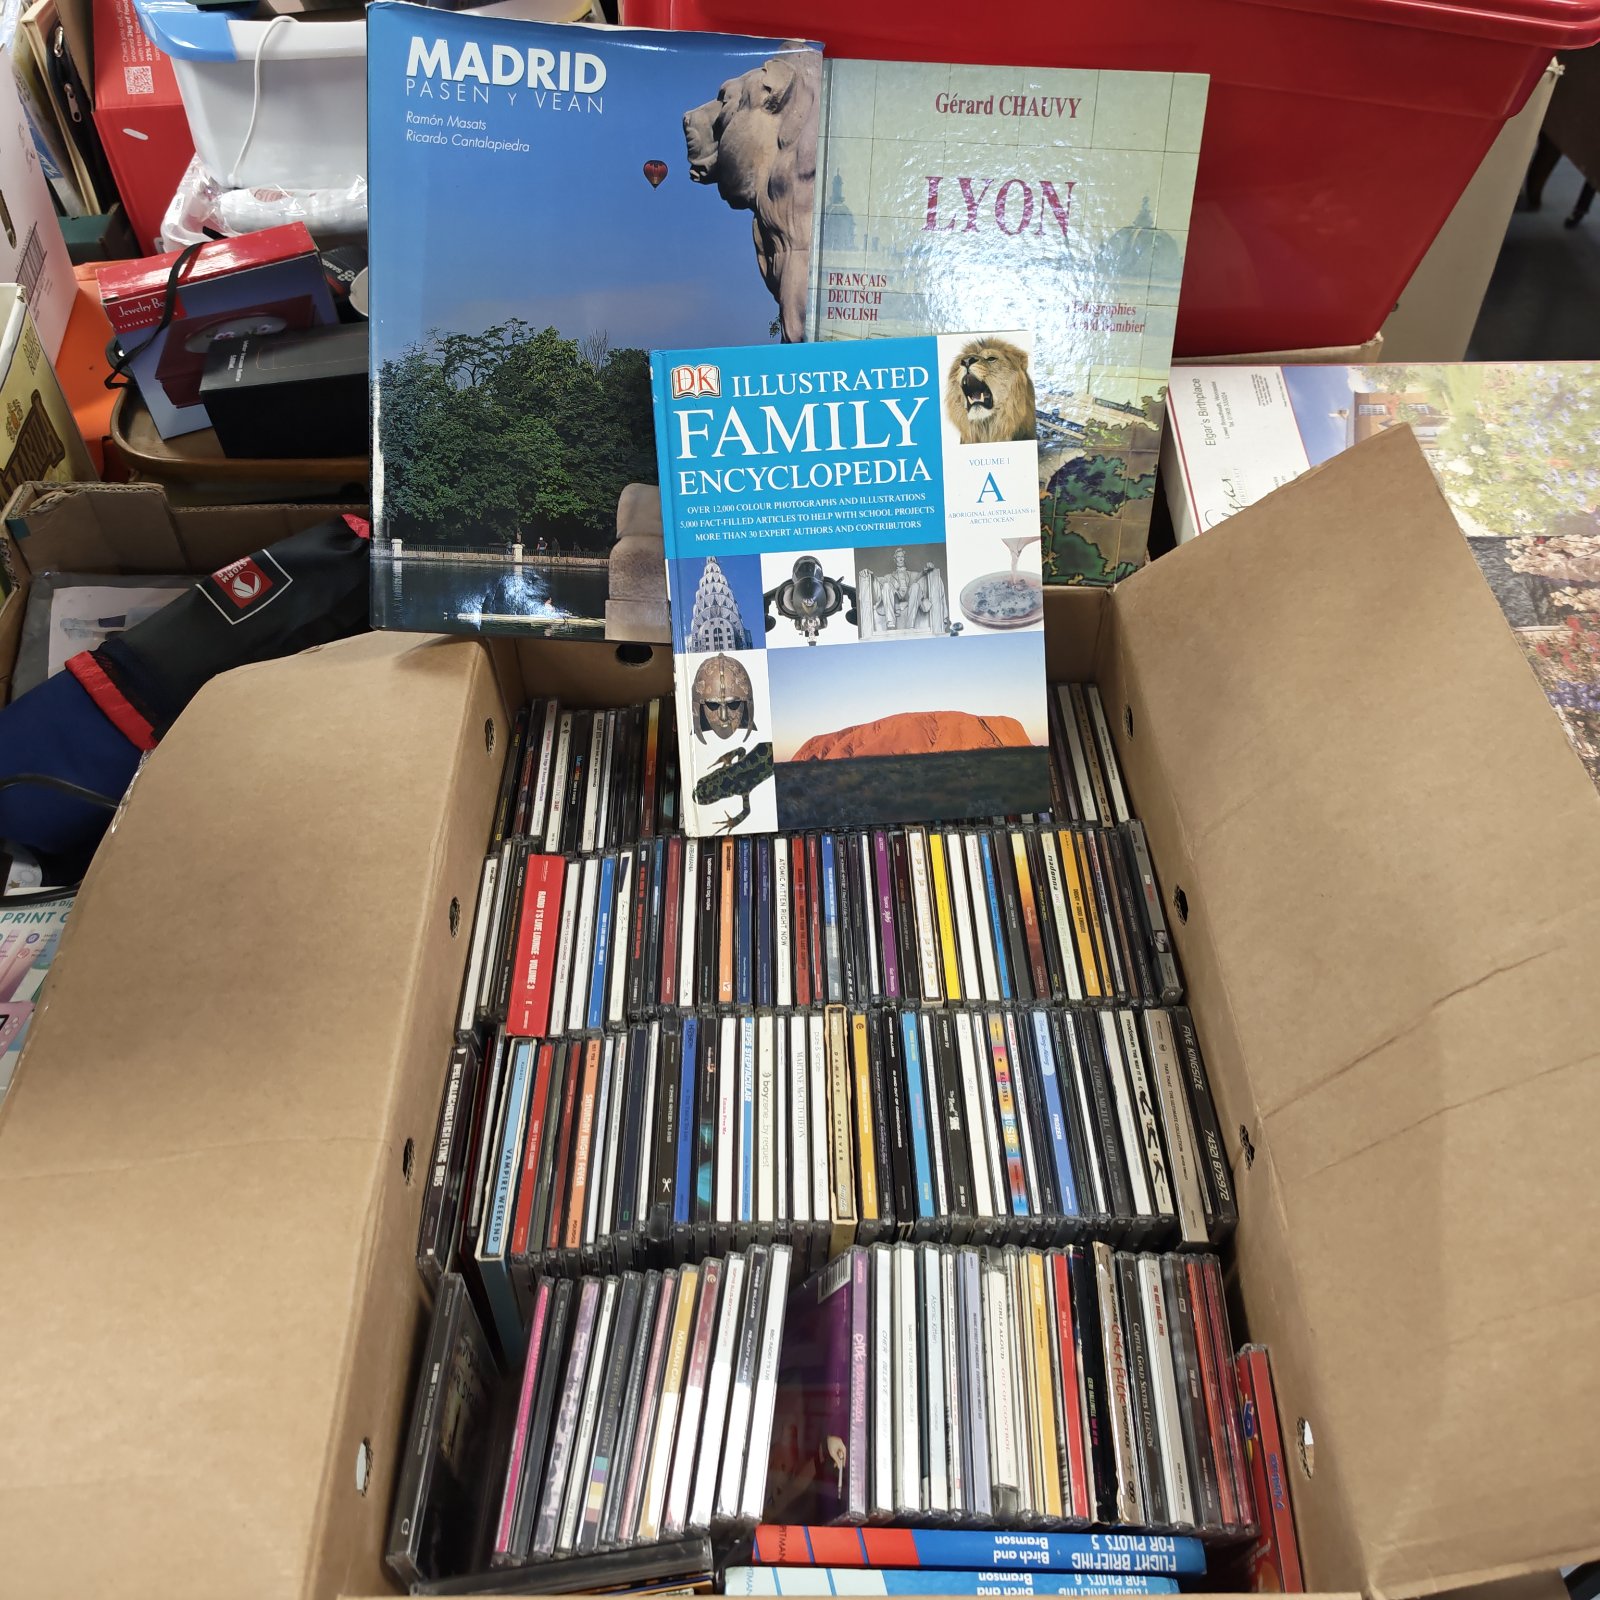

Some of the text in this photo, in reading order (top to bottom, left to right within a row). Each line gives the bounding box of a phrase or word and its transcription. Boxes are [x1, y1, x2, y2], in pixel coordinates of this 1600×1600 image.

[407, 36, 607, 94] MADRID
[406, 79, 603, 114] PASEN Y VEAN
[935, 93, 1082, 118] Gérard CHAUVY
[406, 111, 487, 130] Ramón Masats
[406, 130, 530, 153] Ricardo Cantalapiedra
[922, 176, 1077, 237] LYON
[828, 272, 887, 290] FRANÇAIS
[119, 298, 166, 317] Jewelry Bo
[828, 290, 882, 305] DEUTSCH
[827, 307, 878, 321] ENGLISH
[674, 366, 929, 398] DK ILLUSTRATED
[1192, 378, 1216, 445] Elgar's Birthplace
[673, 397, 930, 460] FAMILY
[969, 457, 1004, 467] VOLUME
[678, 457, 932, 496] ENCYCLOPEDIA
[977, 472, 1006, 503] A
[688, 493, 926, 515] OVER 12,000 COLOUR PHOTOGRAPHS AND ILLUSTRATIONS
[948, 510, 986, 518] ABORIGINAL
[680, 506, 935, 529] 5,000 FACT-FILLED ARTICLES TO HELP WITH SCHOOL PROJECTS
[969, 516, 1014, 525] ARCTIC OCEAN
[695, 520, 921, 542] MORE THAN 30 EXPERT AUTHORS AND CONTRIBUTORS
[222, 560, 247, 583] STORM
[1047, 855, 1058, 890] madonna
[535, 891, 547, 908] RADIO
[0, 912, 57, 924] PRINT
[533, 919, 543, 931] LIVE
[534, 910, 544, 918] 1'S
[530, 932, 542, 955] LOUNGE
[527, 960, 539, 983] VOLUME
[744, 1022, 752, 1102] STEPS STEPTACULAR
[796, 1051, 804, 1084] MARTINE
[1183, 1025, 1203, 1091] FIVE KINGSIZE
[451, 1064, 463, 1080] NOEL
[999, 1072, 1009, 1102] MADONNA
[1091, 1065, 1104, 1094] GEORGE
[1104, 1135, 1116, 1161] OLDER
[441, 1122, 454, 1138] HIGH
[836, 1113, 844, 1161] FOREVER
[1005, 1115, 1017, 1144] MUSIC
[1052, 1114, 1062, 1139] FROZEN
[1170, 1099, 1178, 1122] ULTIMATE
[1174, 1123, 1183, 1152] COLLECTION
[437, 1139, 451, 1162] FLYING
[576, 1094, 592, 1186] SATURDAY NIGHT FEVER
[761, 1137, 770, 1167] request
[433, 1166, 446, 1187] BIRDS
[1204, 1130, 1229, 1201] 74321 875972
[492, 1149, 512, 1242] VAMPIRE WEEKEND
[749, 1265, 761, 1318] ROBBIE WILLIAMS
[768, 1329, 776, 1342] BBC
[931, 1323, 939, 1344] Kitten
[672, 1330, 686, 1368] MARIAH
[741, 1330, 753, 1381] REALITY KILLED
[766, 1343, 774, 1359] RADIO
[1111, 1324, 1126, 1404] CHICK FLICK
[428, 1385, 437, 1396] The
[1002, 1389, 1008, 1401] OF
[1132, 1323, 1154, 1448] CAPITAL GOLD SIXTIES LEGENDS
[1003, 1404, 1011, 1452] CONTROL
[994, 1536, 1048, 1549] Bramson
[1092, 1534, 1175, 1551] FOR PILOTS 5
[993, 1550, 1049, 1564] Birch and
[1072, 1551, 1176, 1571] FLIGHT BRIEFING
[978, 1572, 1033, 1585] Bramson
[977, 1586, 1034, 1597] Birch and
